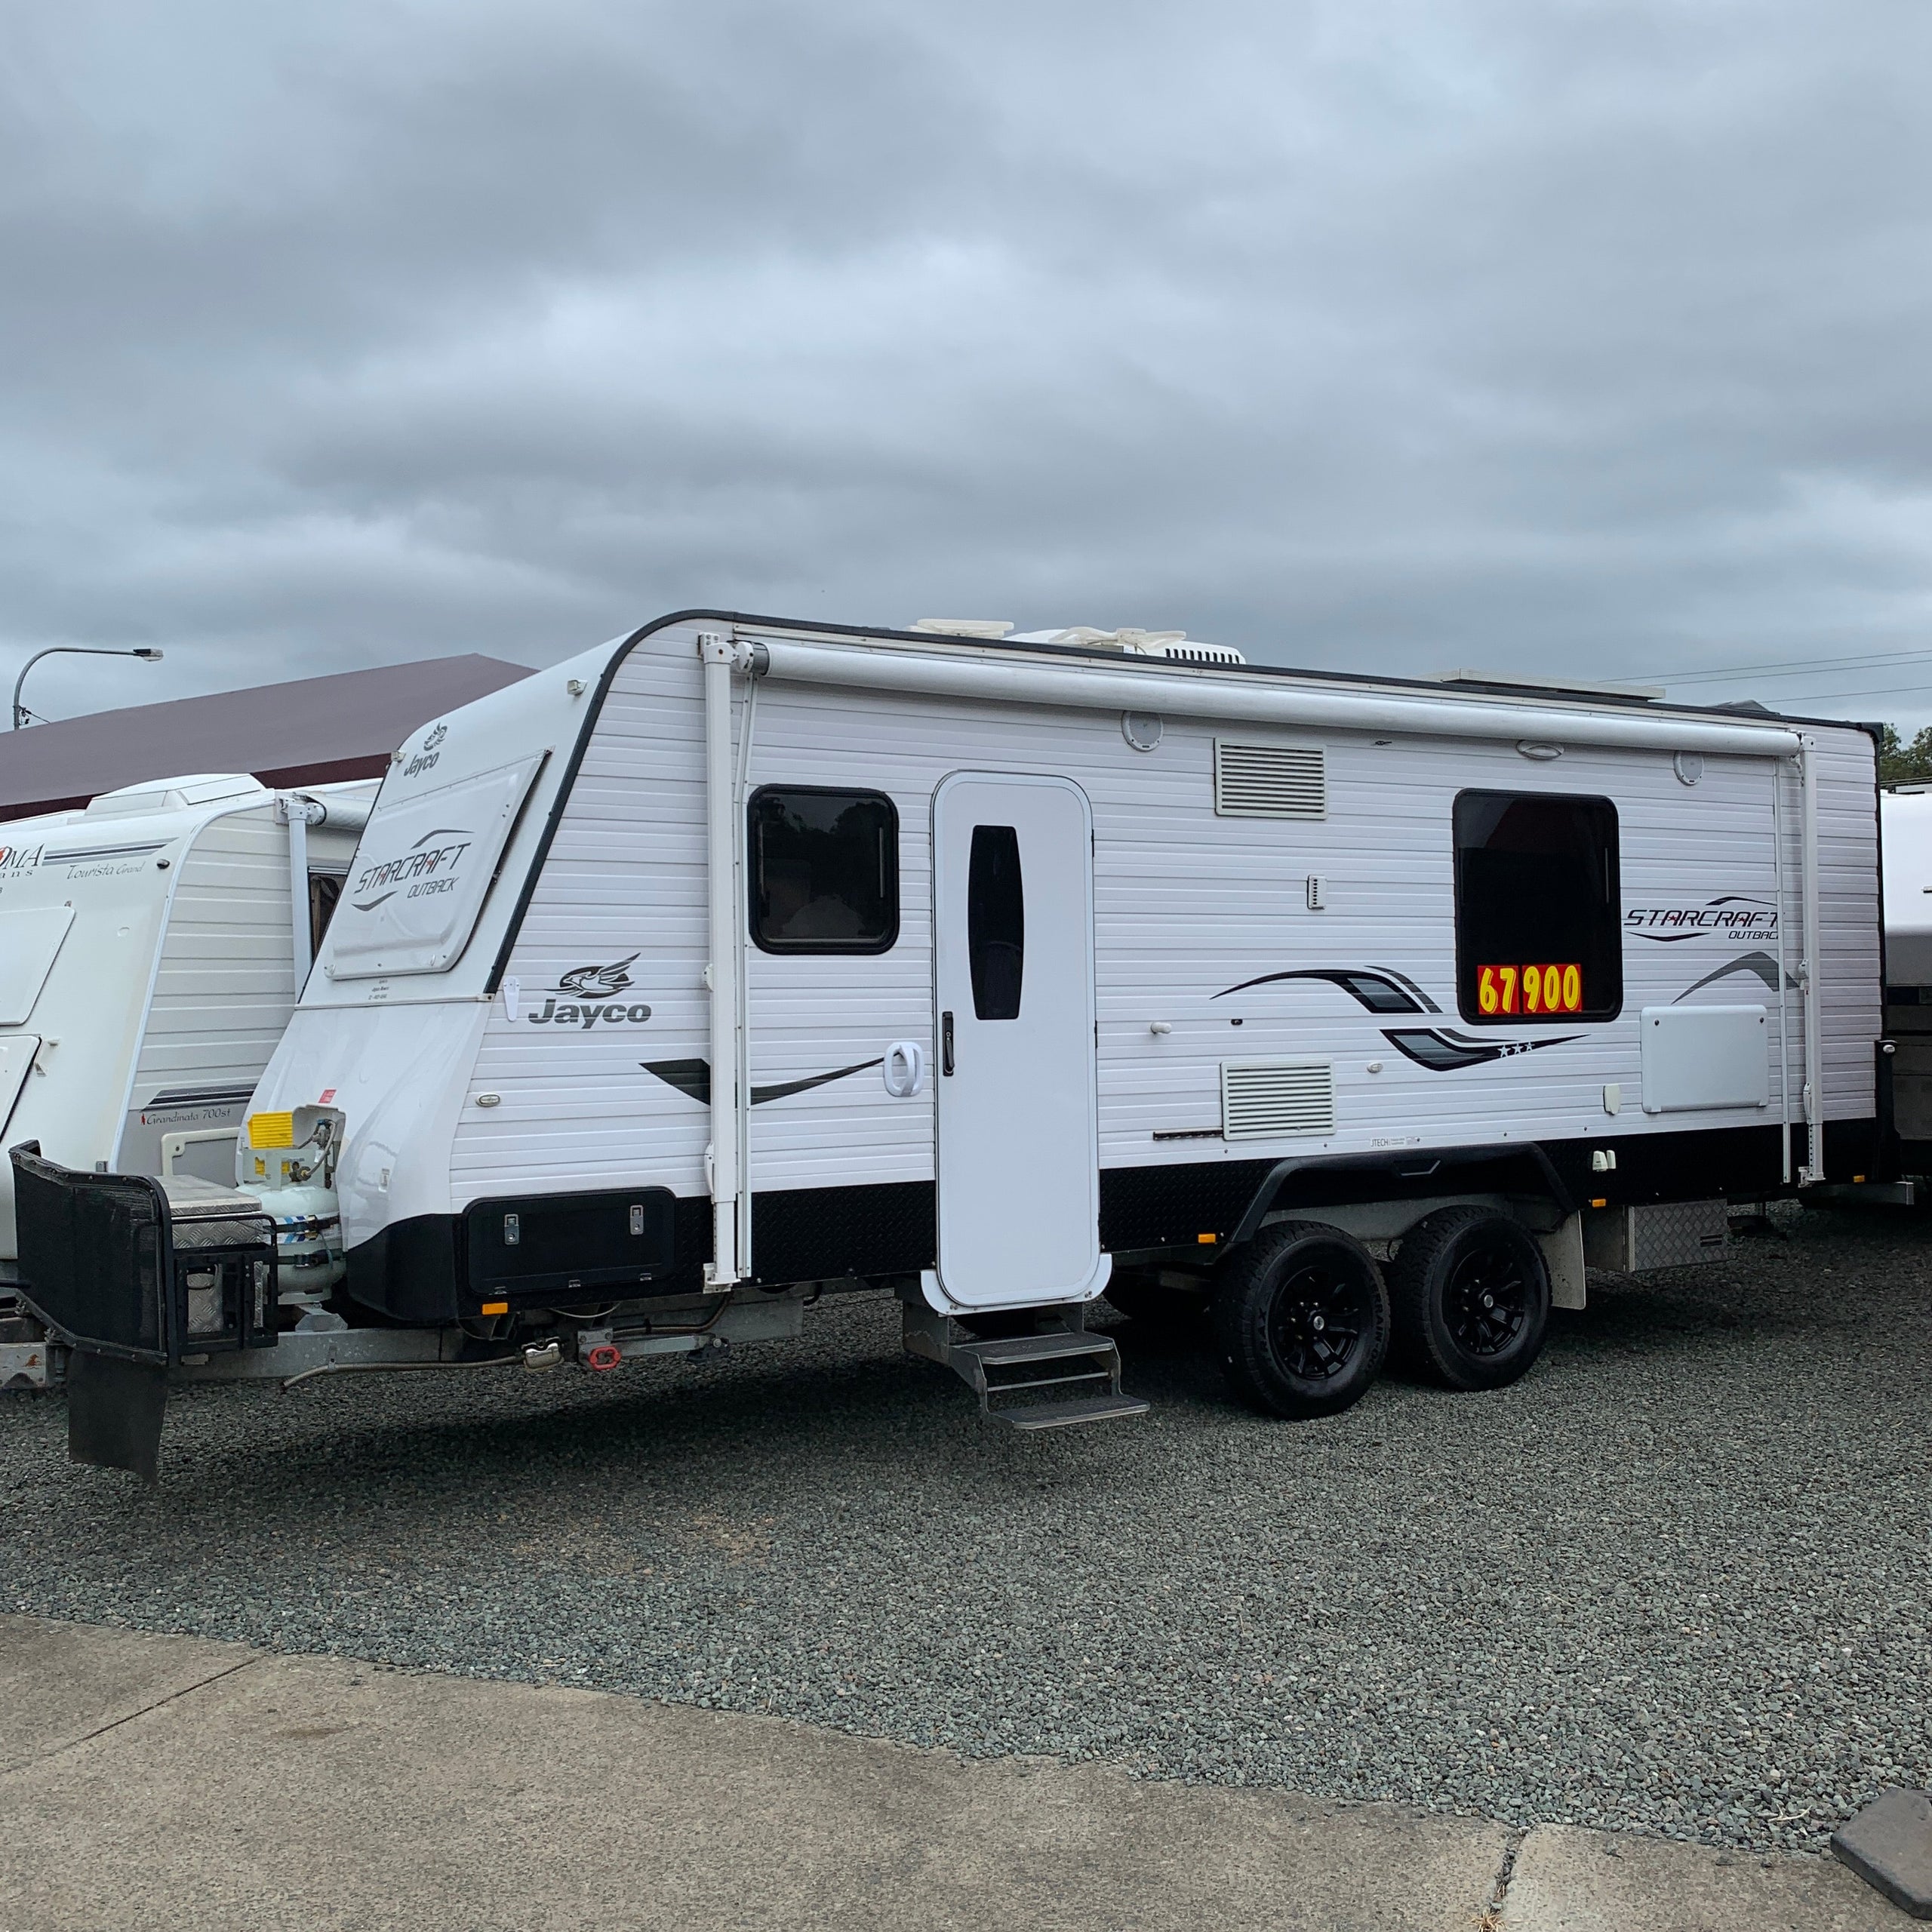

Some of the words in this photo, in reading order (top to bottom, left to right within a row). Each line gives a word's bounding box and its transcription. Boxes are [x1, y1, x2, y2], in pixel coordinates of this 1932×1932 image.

[403, 752, 440, 778] Jayco
[66, 864, 114, 879] Tourista
[354, 842, 472, 894] STARCRAFT
[407, 876, 460, 898] OUTBACK
[1728, 931, 1778, 940] OUTBAC
[528, 998, 652, 1029] Jayco
[1371, 1138, 1389, 1147] JTECH
